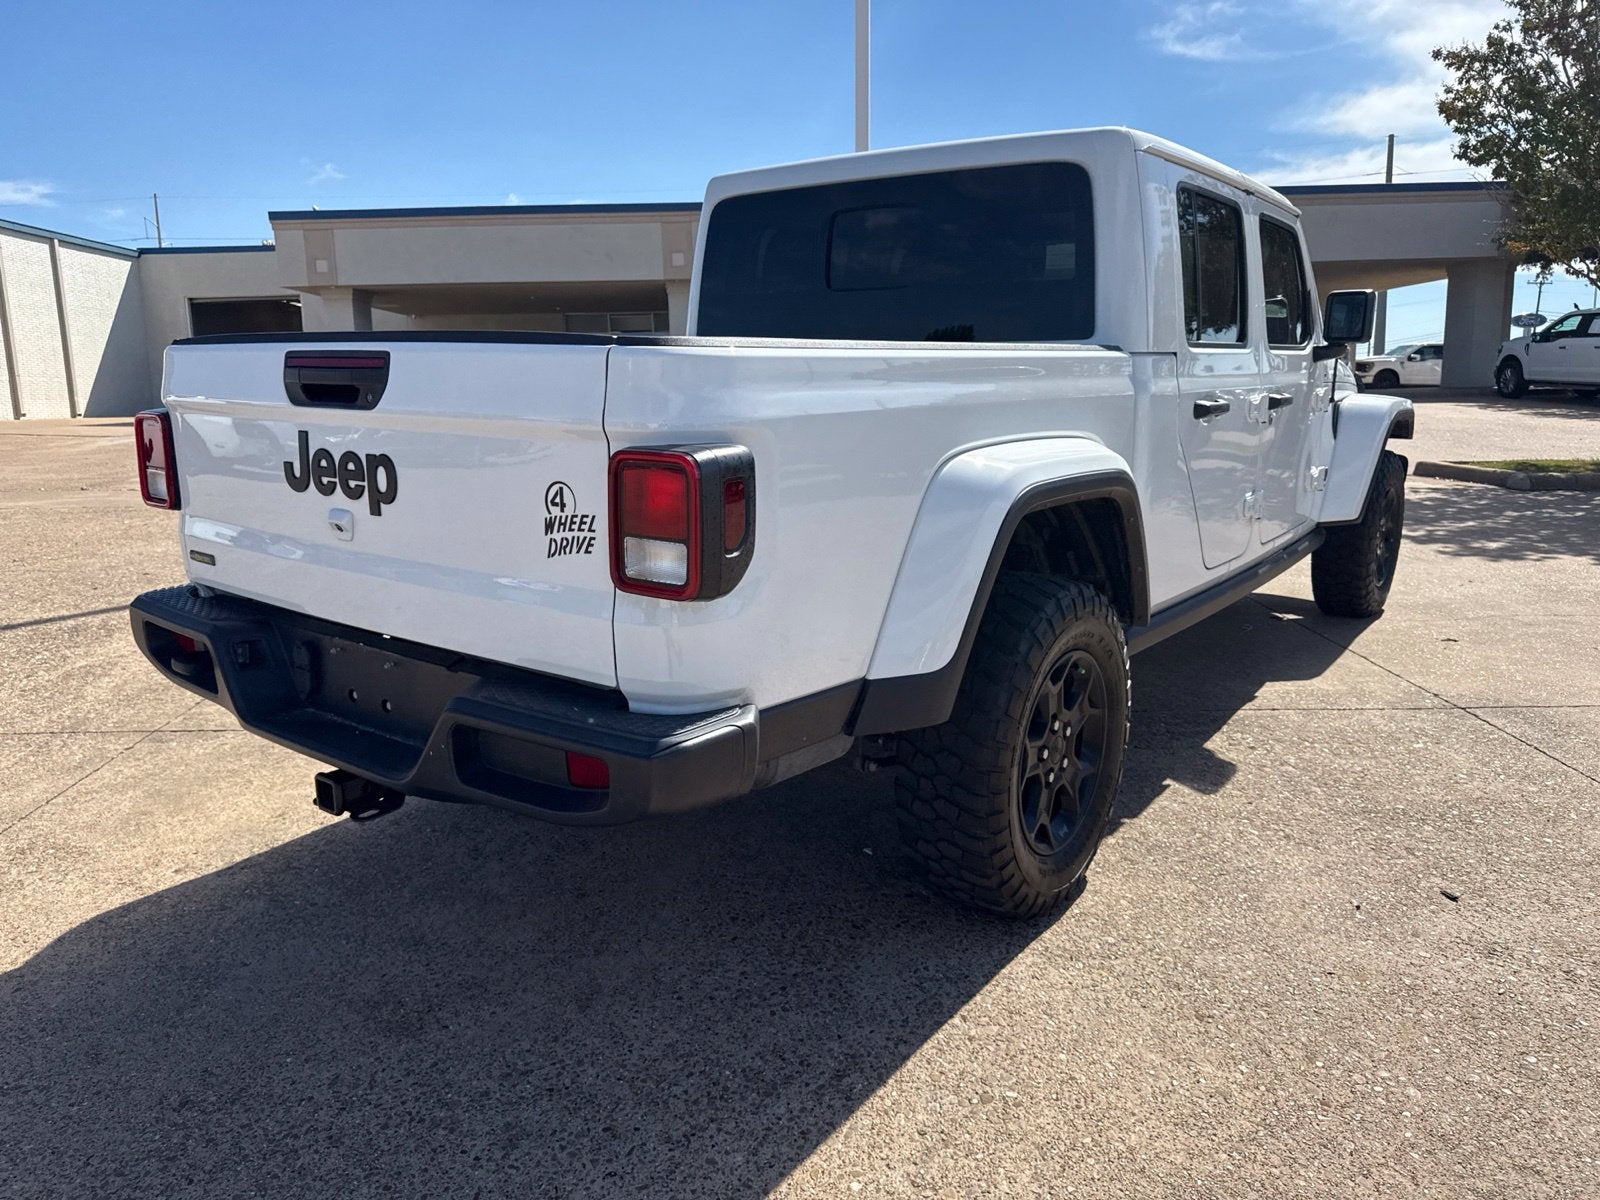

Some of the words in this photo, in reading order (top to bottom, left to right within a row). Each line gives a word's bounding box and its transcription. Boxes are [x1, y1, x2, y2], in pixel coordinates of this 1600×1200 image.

[283, 430, 398, 516] Jeep
[550, 486, 566, 513] 4
[545, 514, 596, 536] WHEEL
[547, 535, 596, 558] DRIVE
